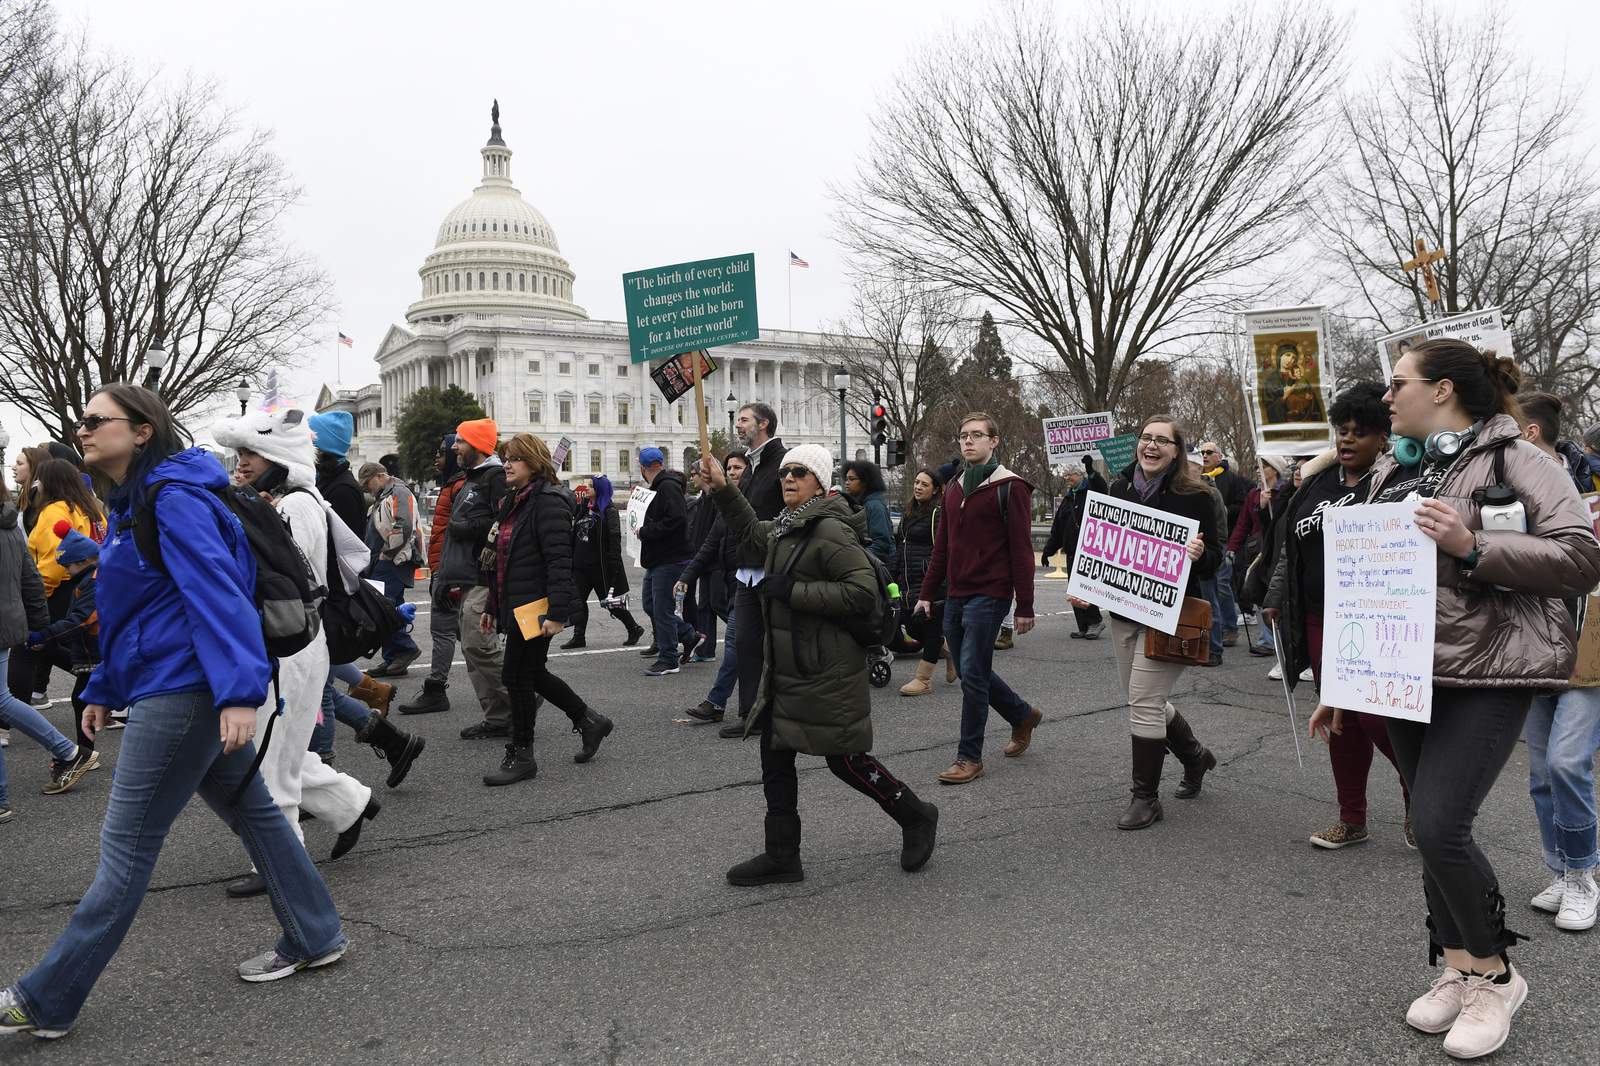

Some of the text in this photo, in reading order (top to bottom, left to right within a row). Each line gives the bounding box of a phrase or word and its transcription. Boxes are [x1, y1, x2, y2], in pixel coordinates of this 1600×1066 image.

[628, 260, 750, 290] "The birth of every child
[643, 281, 735, 308] changes the world:
[636, 299, 744, 328] let every child be born
[1428, 315, 1493, 338] Mary Mother of God
[648, 315, 738, 344] for a better world"
[1048, 425, 1108, 444] CAN NEVER
[1067, 442, 1090, 451] HUMAN
[1089, 501, 1188, 542] TAKING A HUMAN LIFE
[1383, 518, 1402, 531] WAR
[1083, 521, 1183, 576] CAN NEVER
[1367, 551, 1398, 563] VIOLENT
[1400, 551, 1417, 562] ACTS
[1079, 557, 1178, 605] BE A HUMAN RIGHT
[1079, 582, 1164, 619] www.NewWaveFeminists.com
[1402, 685, 1425, 713] Paul
